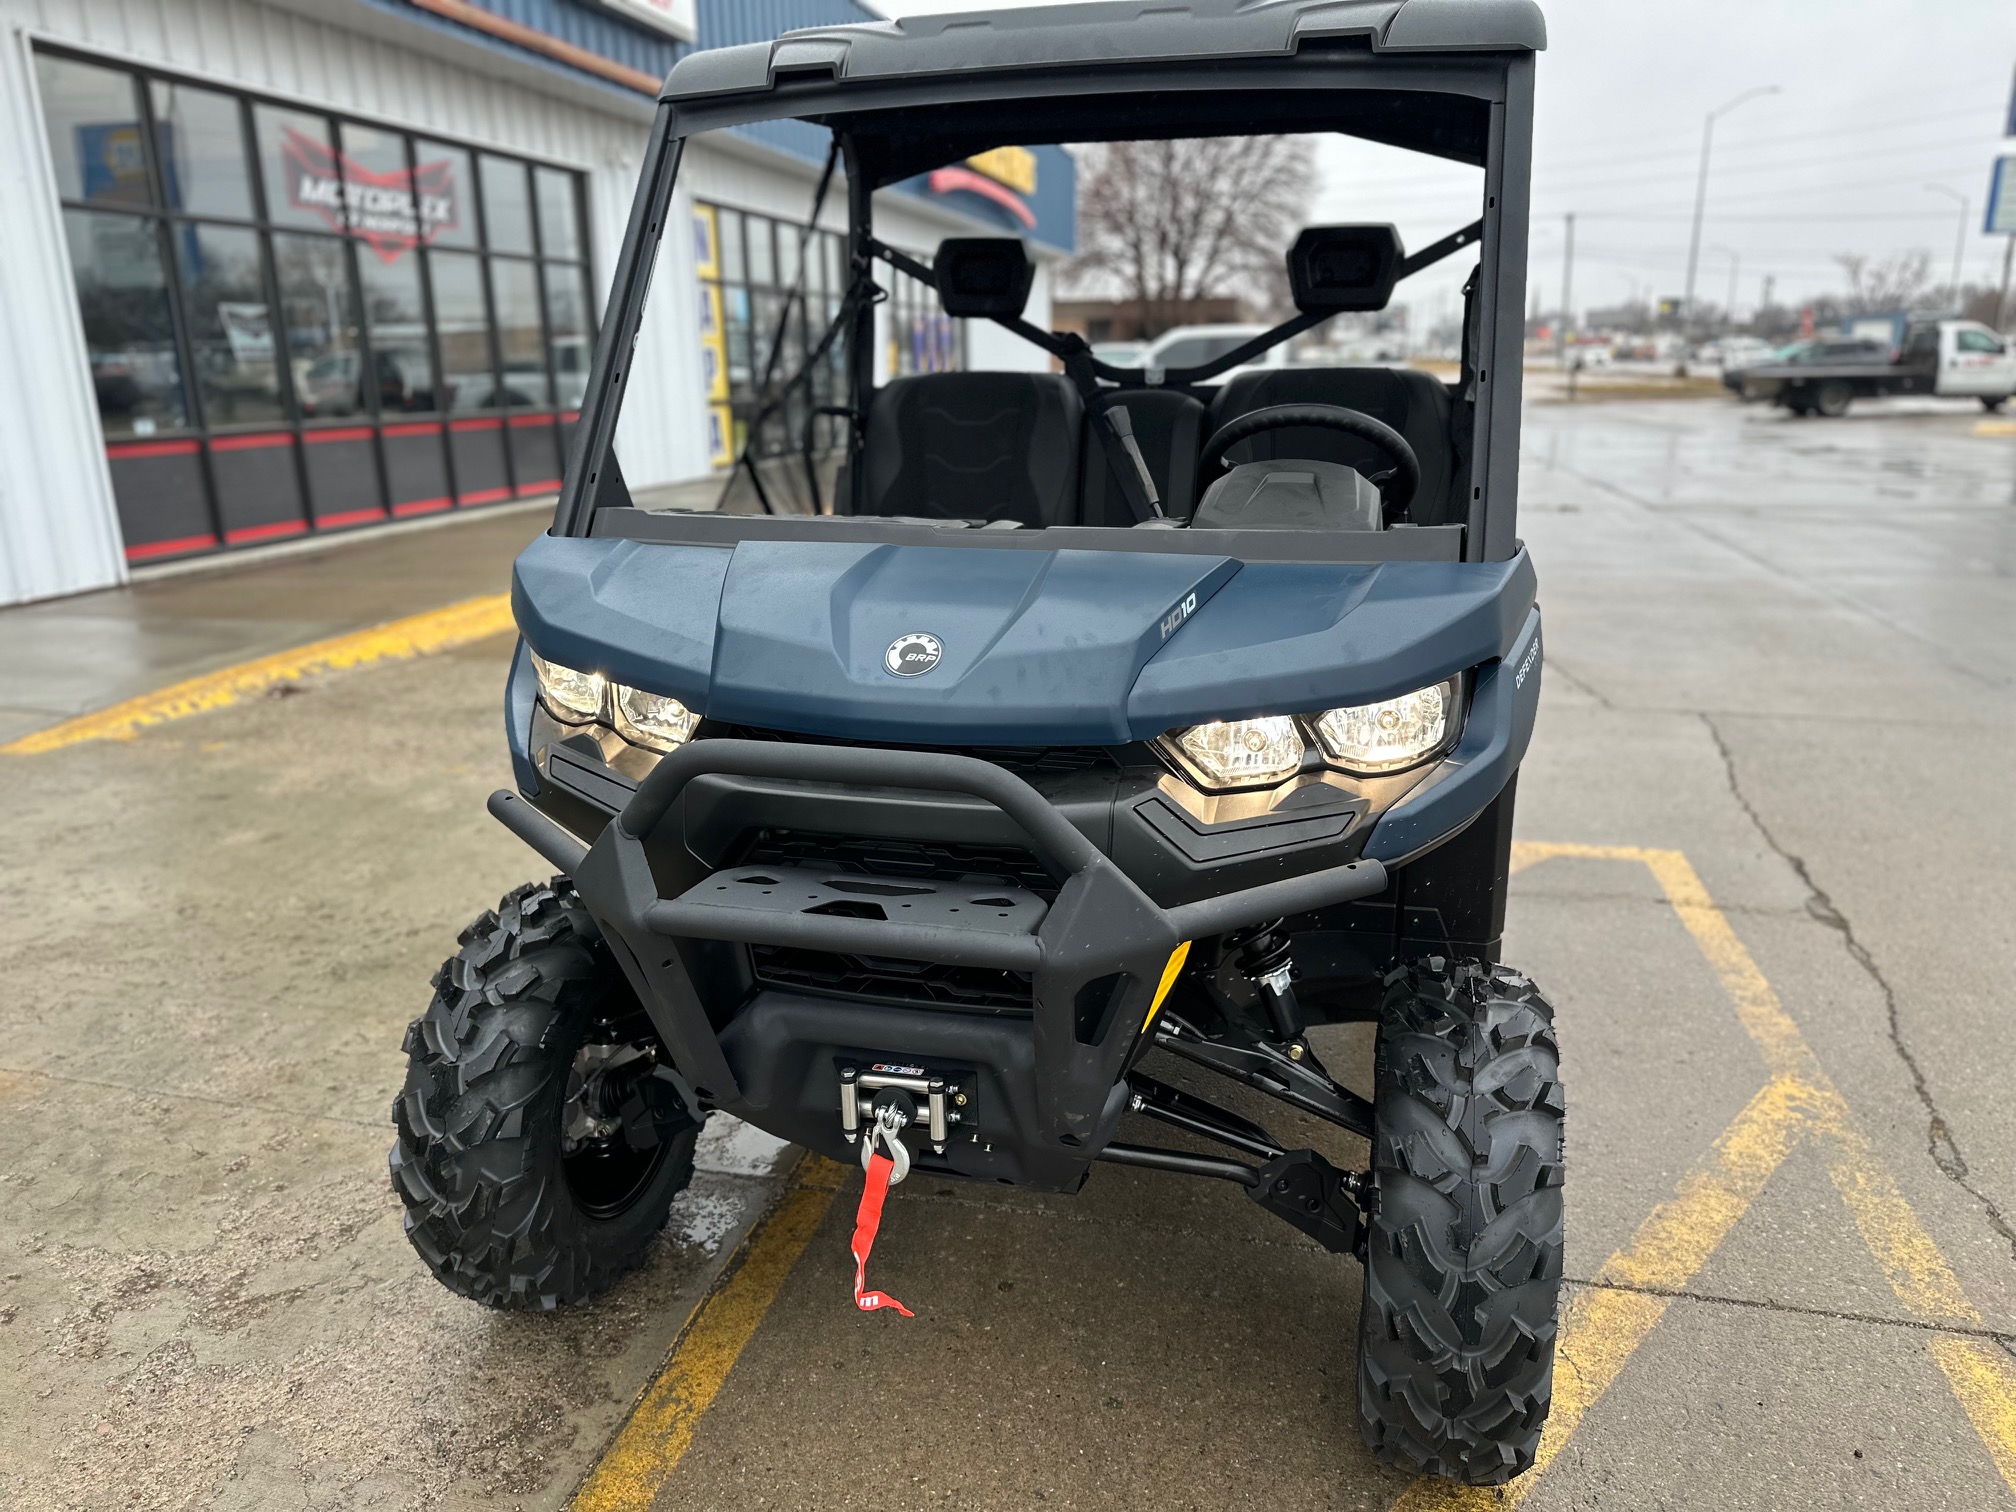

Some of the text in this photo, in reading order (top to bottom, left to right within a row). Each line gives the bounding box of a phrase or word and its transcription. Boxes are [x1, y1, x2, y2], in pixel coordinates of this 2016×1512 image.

[300, 175, 450, 221] MOTOPLEX
[1160, 592, 1196, 639] HD10
[905, 653, 938, 662] BRP
[1515, 637, 1540, 690] DEFENDER
